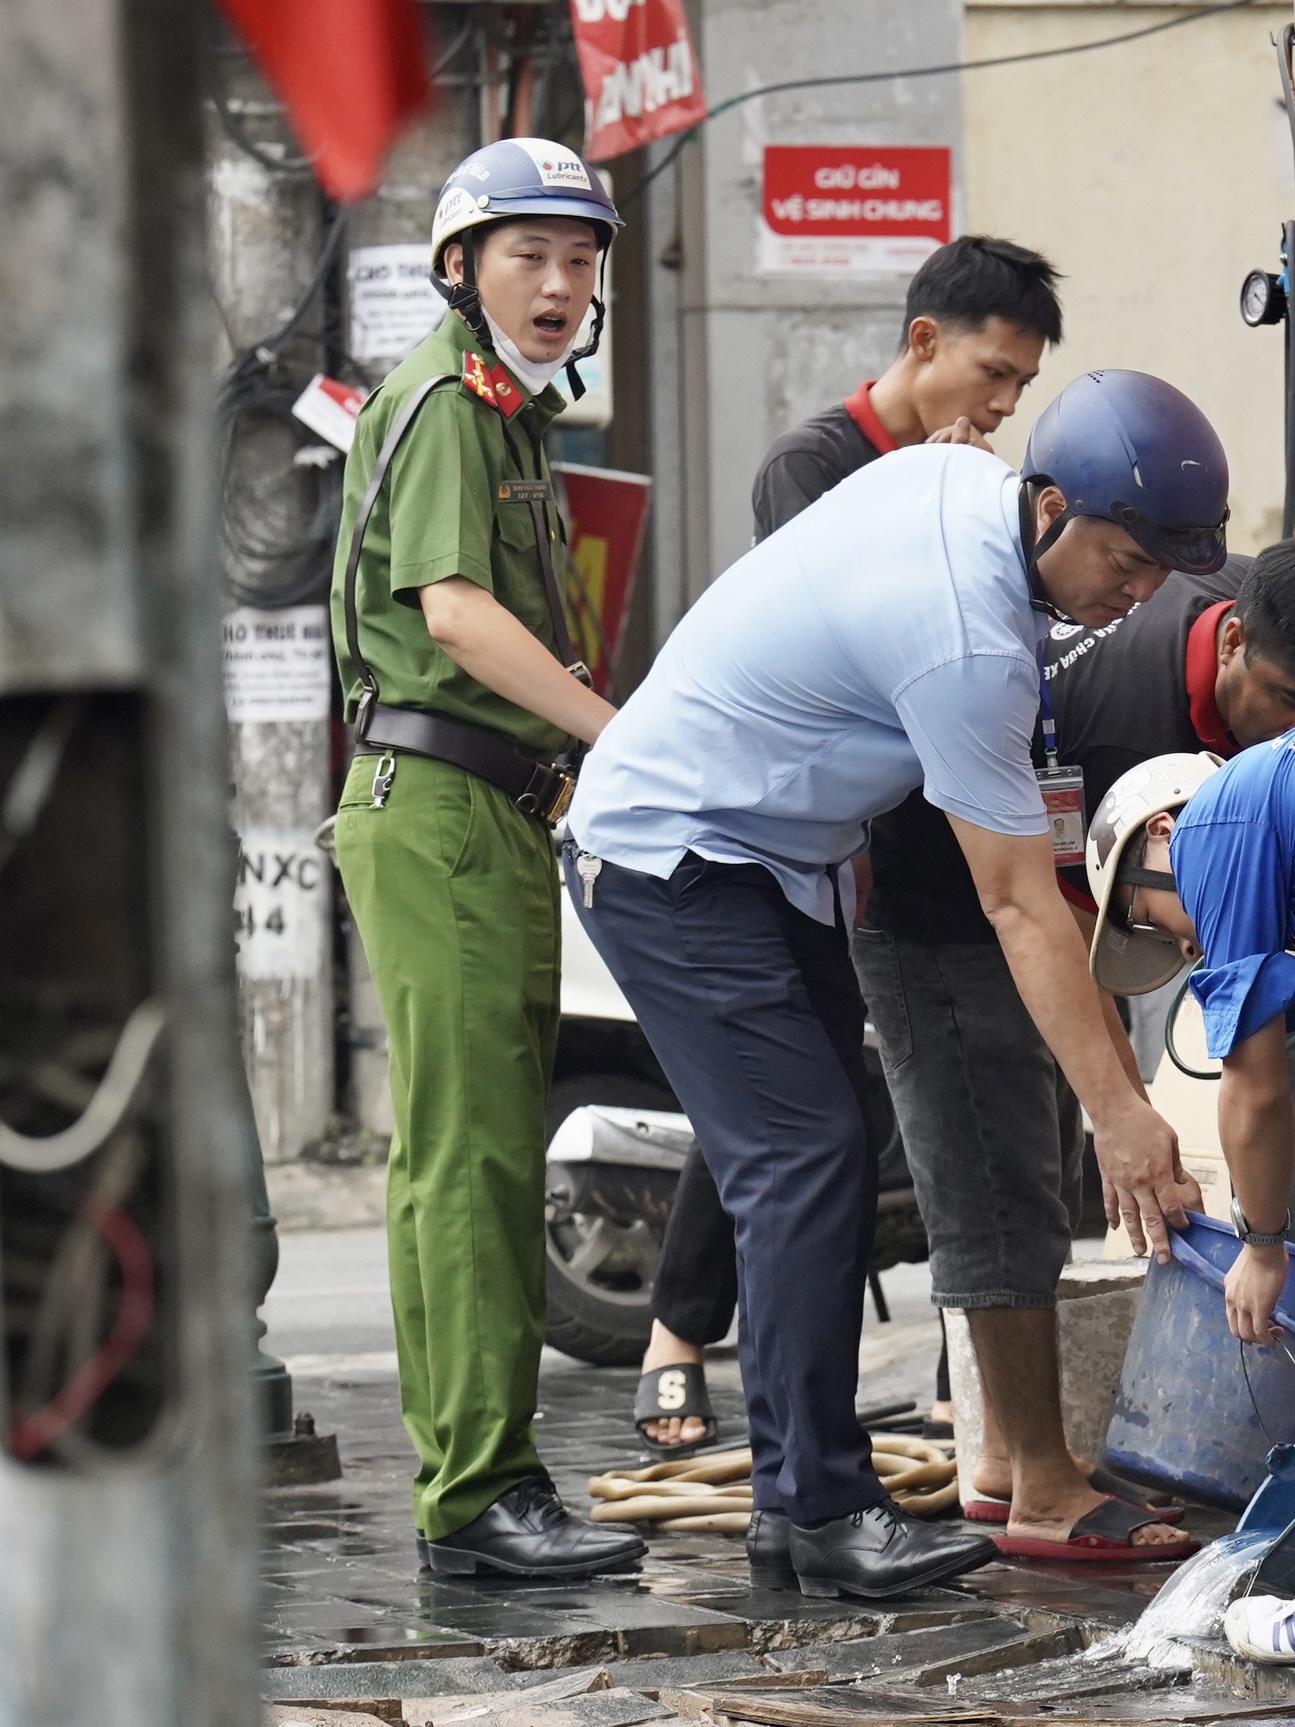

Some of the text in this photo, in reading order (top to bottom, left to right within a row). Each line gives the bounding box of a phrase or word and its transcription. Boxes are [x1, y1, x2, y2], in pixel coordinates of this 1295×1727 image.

[558, 161, 582, 173] ptt
[547, 172, 588, 183] Lubricants
[658, 1369, 686, 1411] S
